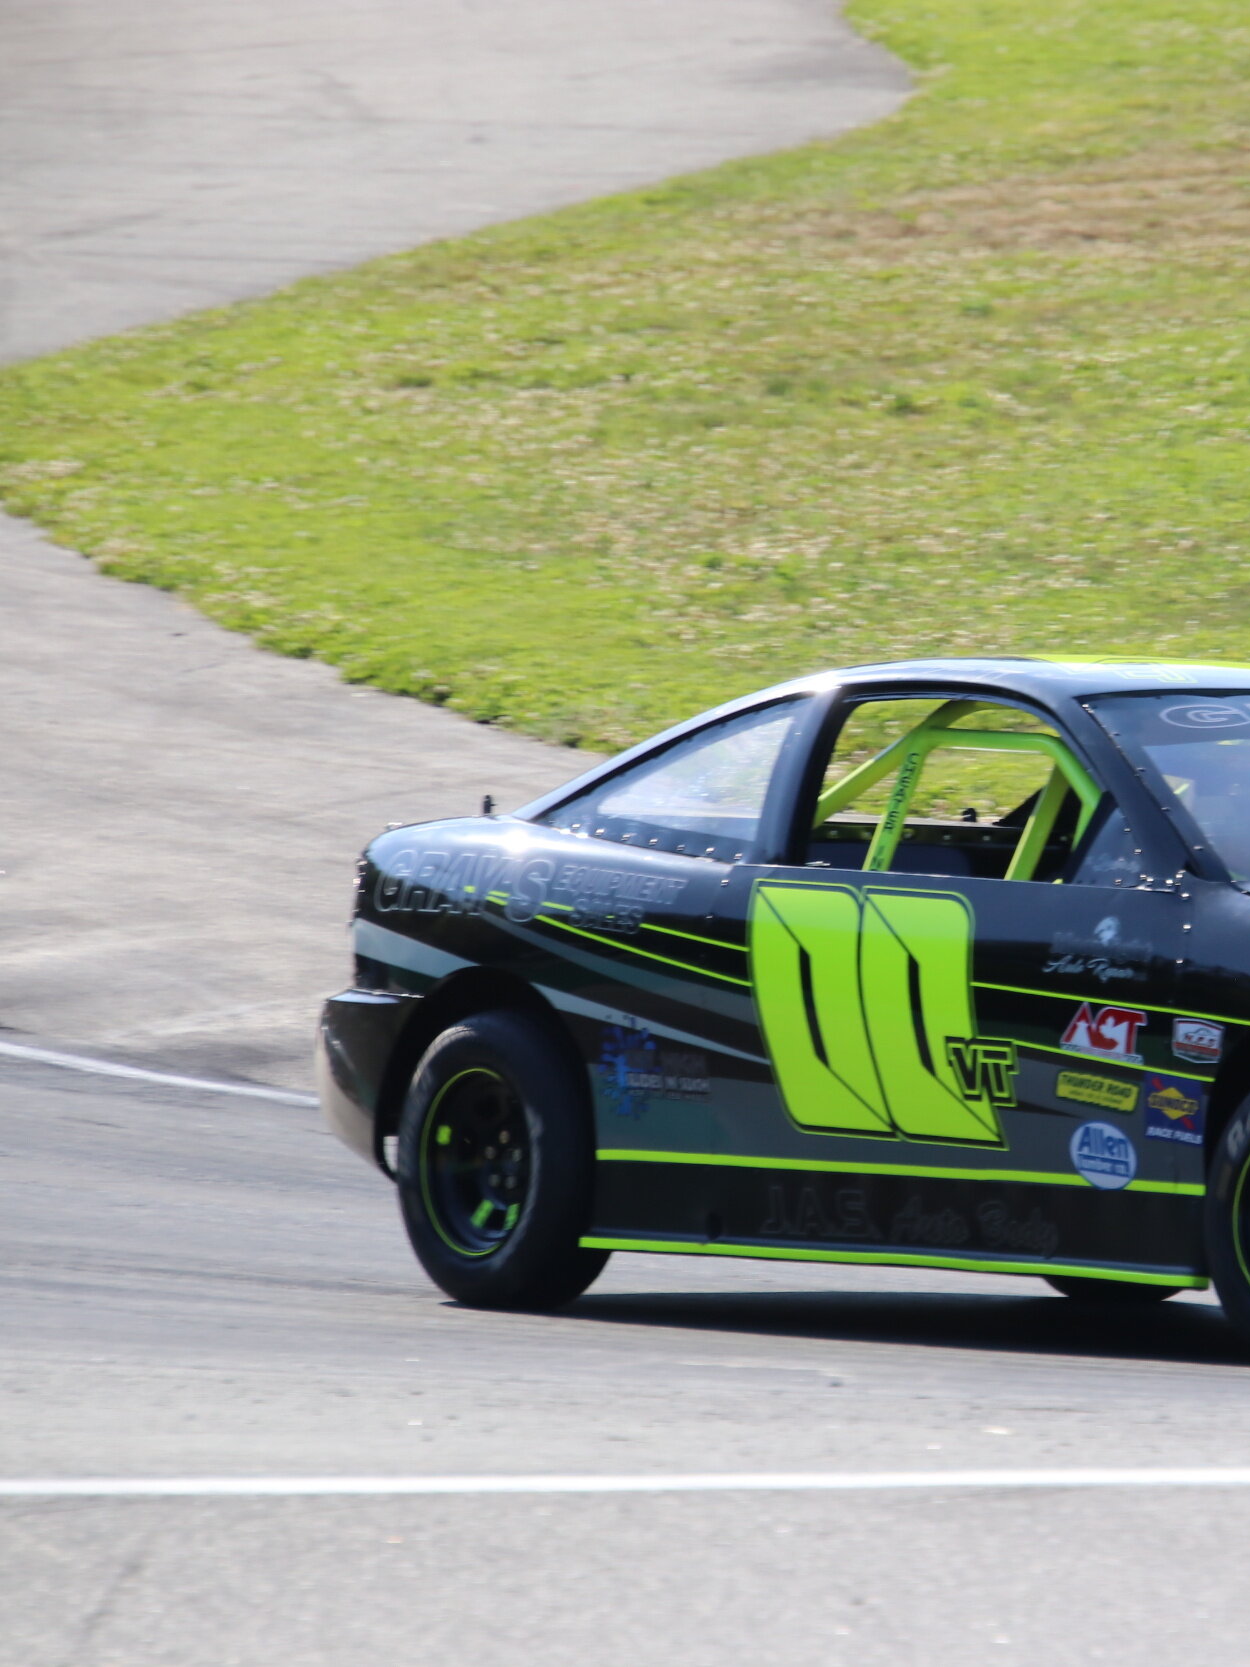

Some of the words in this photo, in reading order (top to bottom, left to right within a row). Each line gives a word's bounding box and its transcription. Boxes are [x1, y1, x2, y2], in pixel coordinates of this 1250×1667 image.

[746, 878, 1009, 1151] 00
[945, 1036, 1019, 1107] VT
[1062, 1003, 1147, 1056] ACT
